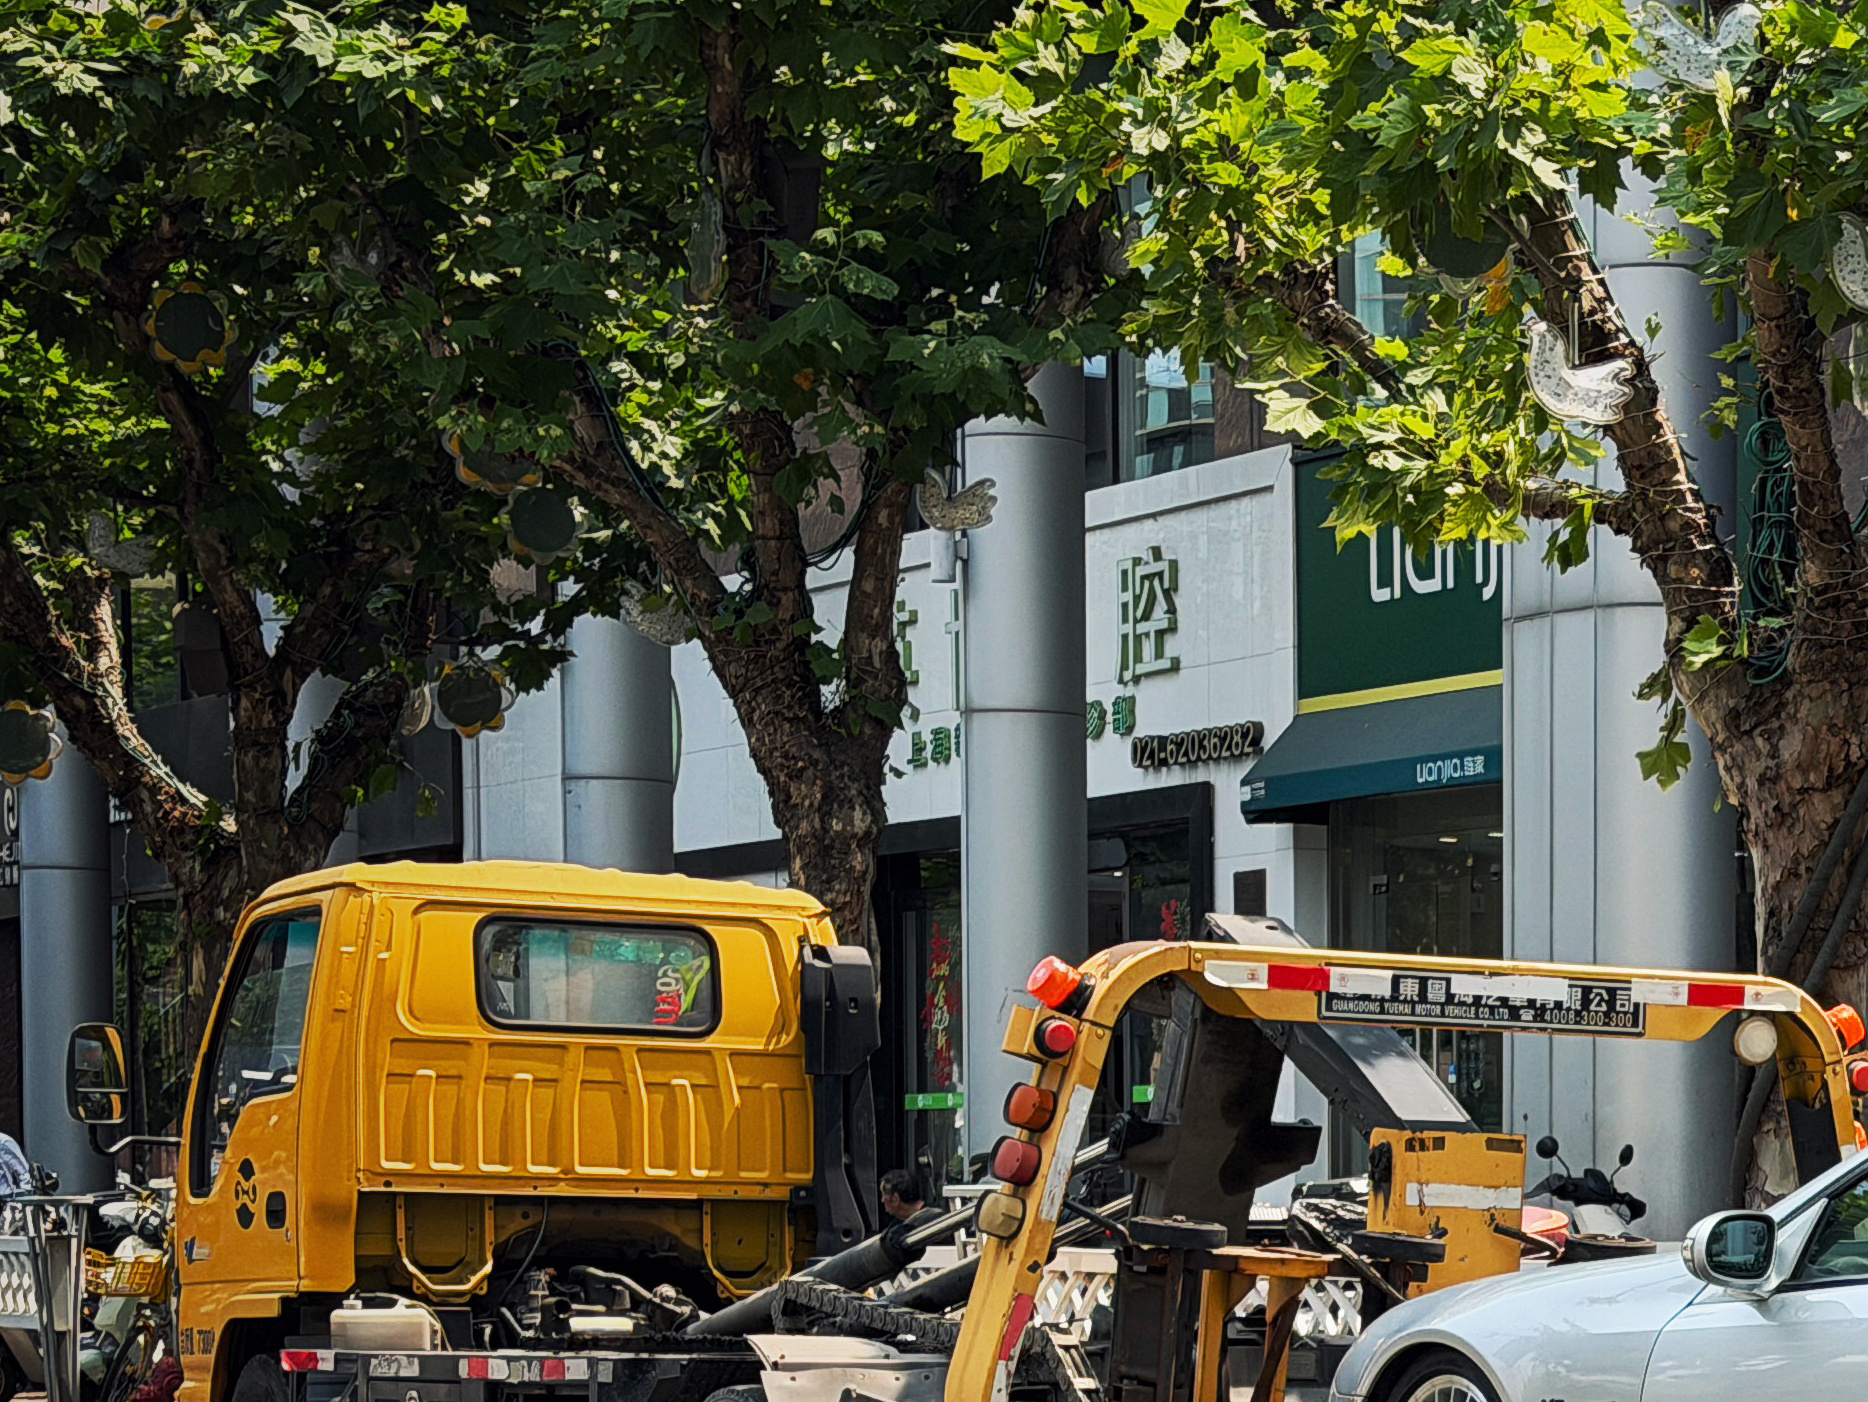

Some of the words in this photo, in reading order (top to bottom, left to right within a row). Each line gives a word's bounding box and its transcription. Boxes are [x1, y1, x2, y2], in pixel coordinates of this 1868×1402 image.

[1132, 720, 1260, 769] 021-62036282
[1414, 1005, 1442, 1017] MOTOR
[1443, 1006, 1477, 1019] VEHICLE
